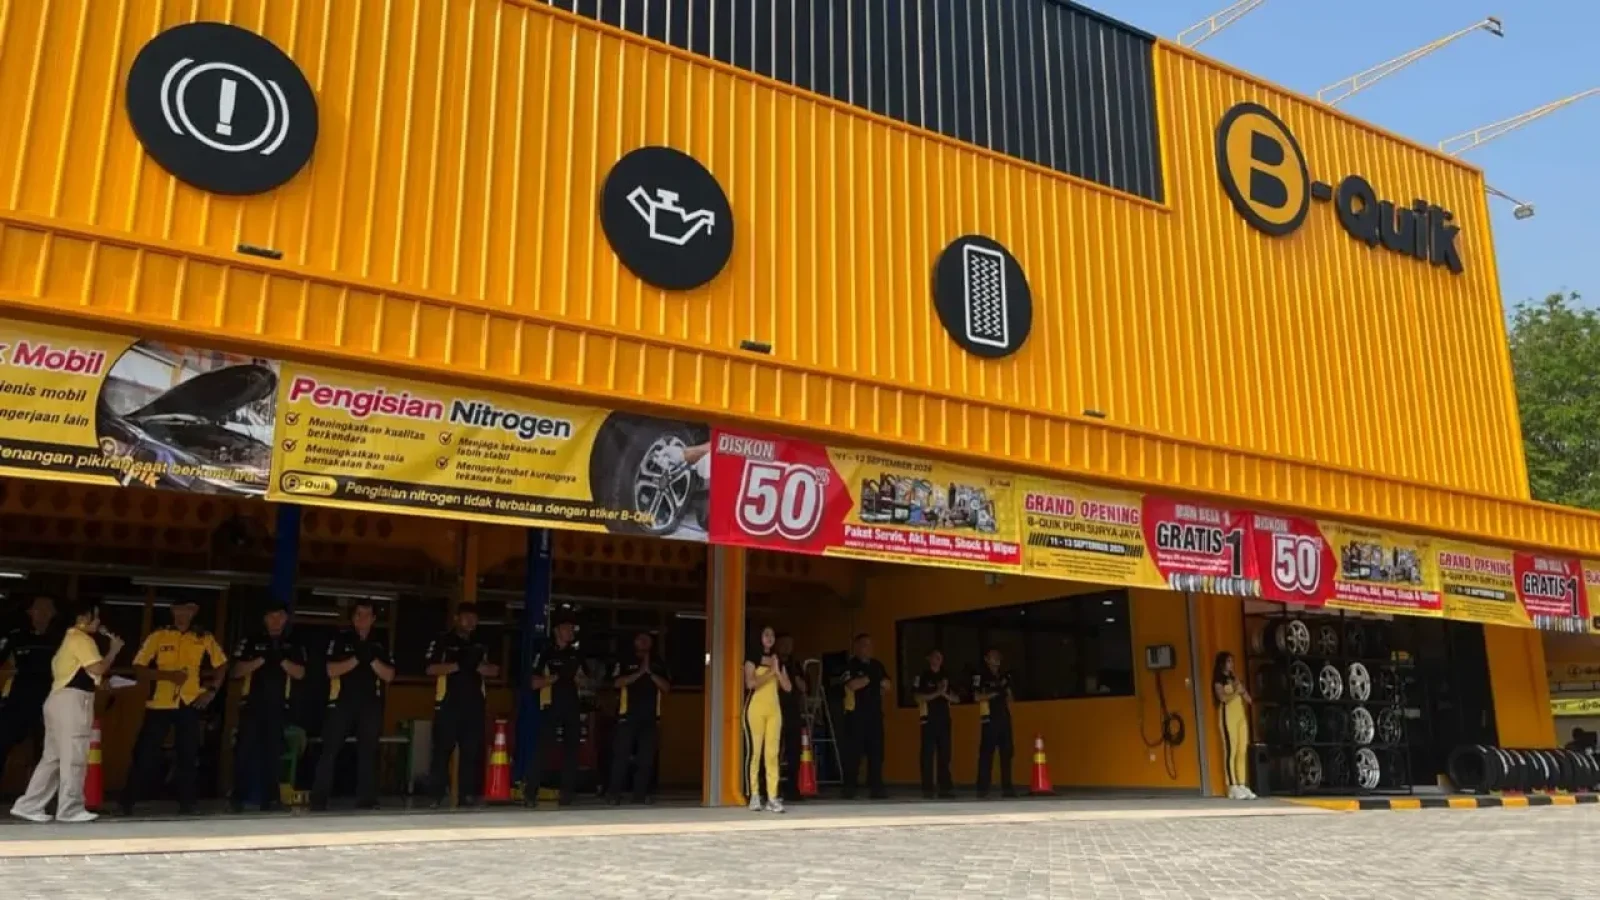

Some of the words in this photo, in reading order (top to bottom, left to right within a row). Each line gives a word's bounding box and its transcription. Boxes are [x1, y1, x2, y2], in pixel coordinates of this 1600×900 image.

[1215, 102, 1463, 274] B-Quik
[12, 340, 105, 376] Mobil
[40, 387, 87, 402] mobil
[290, 376, 445, 420] Pengisian
[450, 399, 572, 438] Nitrogen
[64, 414, 90, 427] lain
[308, 416, 382, 434] Meningkatkan
[385, 425, 426, 441] kualitas
[306, 429, 366, 444] berkendara
[458, 437, 499, 450] Menjaga
[501, 442, 538, 455] tekanan
[540, 447, 557, 456] ban
[718, 433, 774, 459] DISKON
[303, 456, 362, 469] pemakaian
[365, 460, 385, 471] ban
[305, 444, 380, 460] Meningkatkan
[484, 449, 510, 461] stabil
[866, 455, 912, 470] SEPTEMBER
[456, 461, 529, 477] Memperlambat
[530, 470, 577, 483] kurangnya
[345, 481, 406, 499] Pengisian
[409, 489, 460, 506] nitrogen
[463, 494, 492, 507] tidak
[495, 498, 543, 513] terbatas
[545, 503, 587, 518] dengan
[590, 507, 619, 520] stiker
[1025, 493, 1075, 516] GRAND
[1079, 500, 1140, 525] OPENING
[844, 525, 872, 539] Paket
[955, 538, 981, 551] Shock
[1026, 516, 1062, 530] B-QUIK
[1063, 521, 1085, 532] PURI
[1087, 523, 1117, 536] SURYA
[1118, 528, 1141, 539] JAYA
[1156, 521, 1224, 555] GRATIS
[1225, 528, 1243, 578] 1
[1439, 552, 1470, 569] GRAND
[1474, 557, 1511, 575] OPENING
[1522, 571, 1566, 599] GRATIS
[1566, 576, 1579, 616] 1
